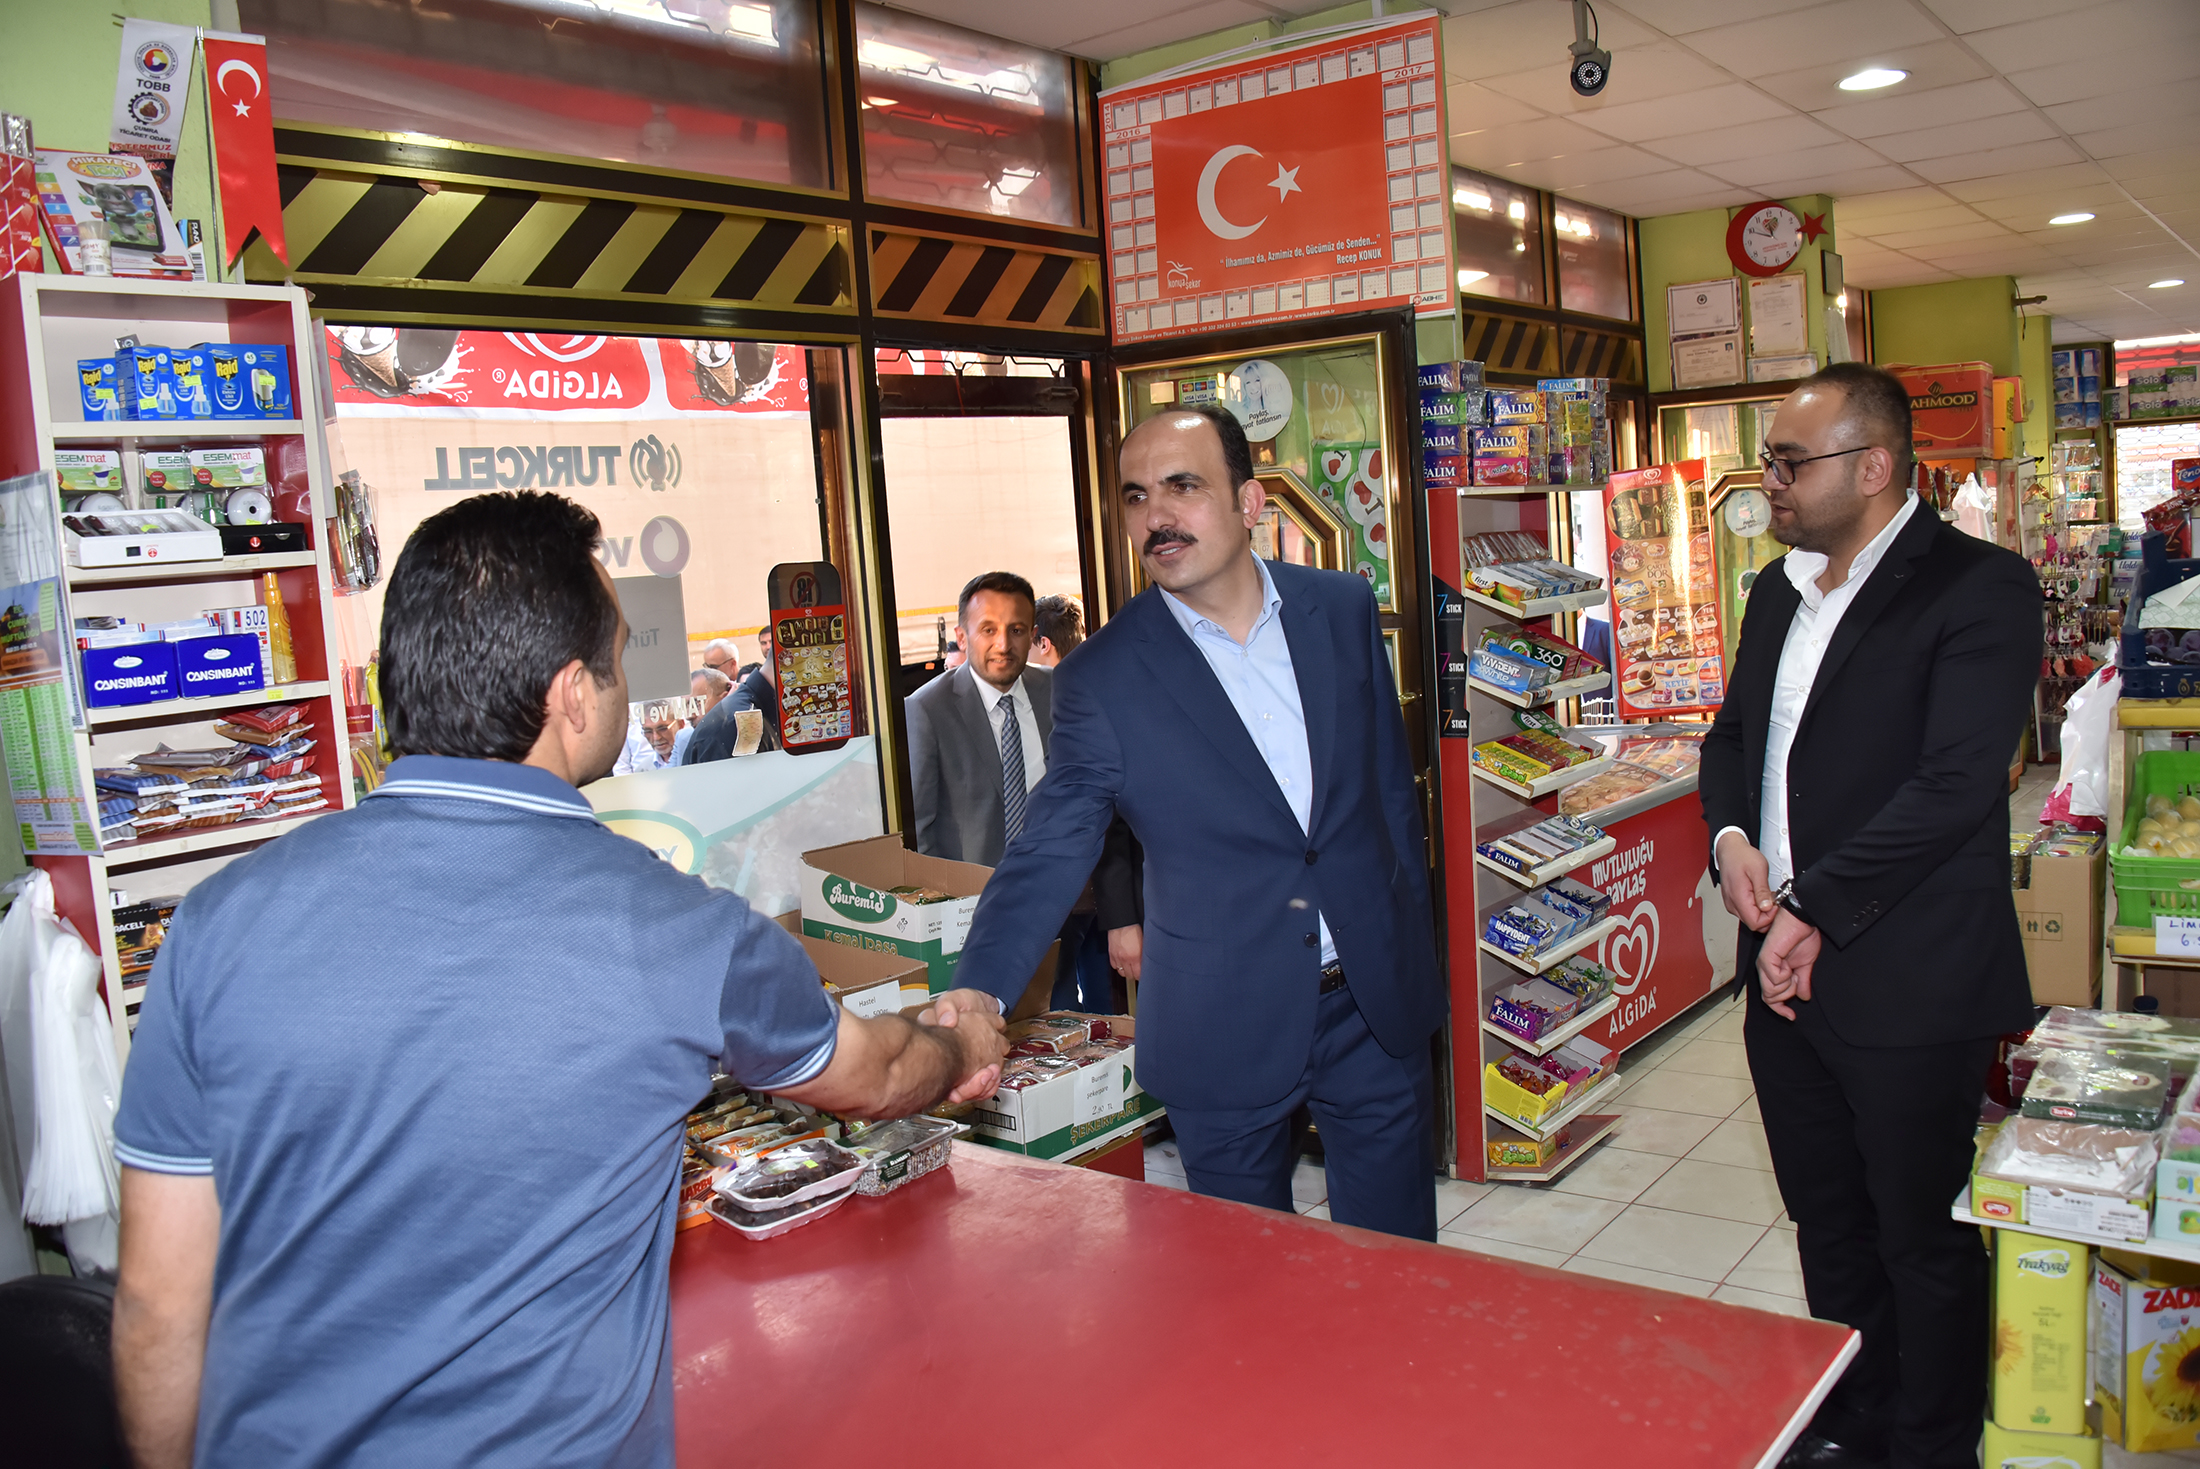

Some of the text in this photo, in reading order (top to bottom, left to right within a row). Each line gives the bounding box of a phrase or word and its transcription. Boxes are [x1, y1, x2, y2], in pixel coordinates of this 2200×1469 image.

[1394, 66, 1422, 78] 2017
[136, 78, 171, 93] TOBB
[119, 128, 148, 139] TİCARET
[133, 125, 159, 134] ÇUMRA
[1116, 128, 1141, 139] 2016
[125, 143, 172, 151] TEMMUZ
[87, 165, 127, 178] TOM
[1267, 250, 1293, 262] Azmimiz
[1336, 240, 1345, 250] de
[1336, 248, 1382, 265] Recep KONUK
[137, 358, 156, 374] Raid
[174, 360, 192, 377] Raid
[215, 360, 239, 377] Raid
[83, 369, 102, 386] Raid
[1418, 374, 1448, 387] FALIM
[1549, 381, 1573, 390] FALIM
[1910, 393, 1975, 409] AHMOOD
[2138, 401, 2161, 409] Solo
[1420, 404, 1455, 417] FALIM
[1498, 402, 1534, 415] FALIM
[1240, 420, 1254, 431] ayat
[1422, 435, 1456, 447] FALIM
[1479, 436, 1516, 448] FALIM
[1423, 466, 1456, 478] FALIM
[1474, 574, 1489, 586] first
[1436, 594, 1462, 617] 7 STICK
[245, 609, 266, 627] 502
[1440, 652, 1465, 675] 7 STICK
[186, 666, 254, 682] CANSINBANT
[94, 673, 167, 691] CANSINBANT
[1442, 709, 1468, 732] 7 STICK
[1523, 716, 1537, 728] first
[1494, 852, 1520, 870] FALIM
[958, 907, 975, 916] Burem
[113, 921, 146, 933] RACELL
[1494, 919, 1531, 944] HAPPYDENT
[858, 997, 877, 1007] Hastel
[1494, 1004, 1531, 1030] FALIM
[2098, 1270, 2122, 1297] ZADE
